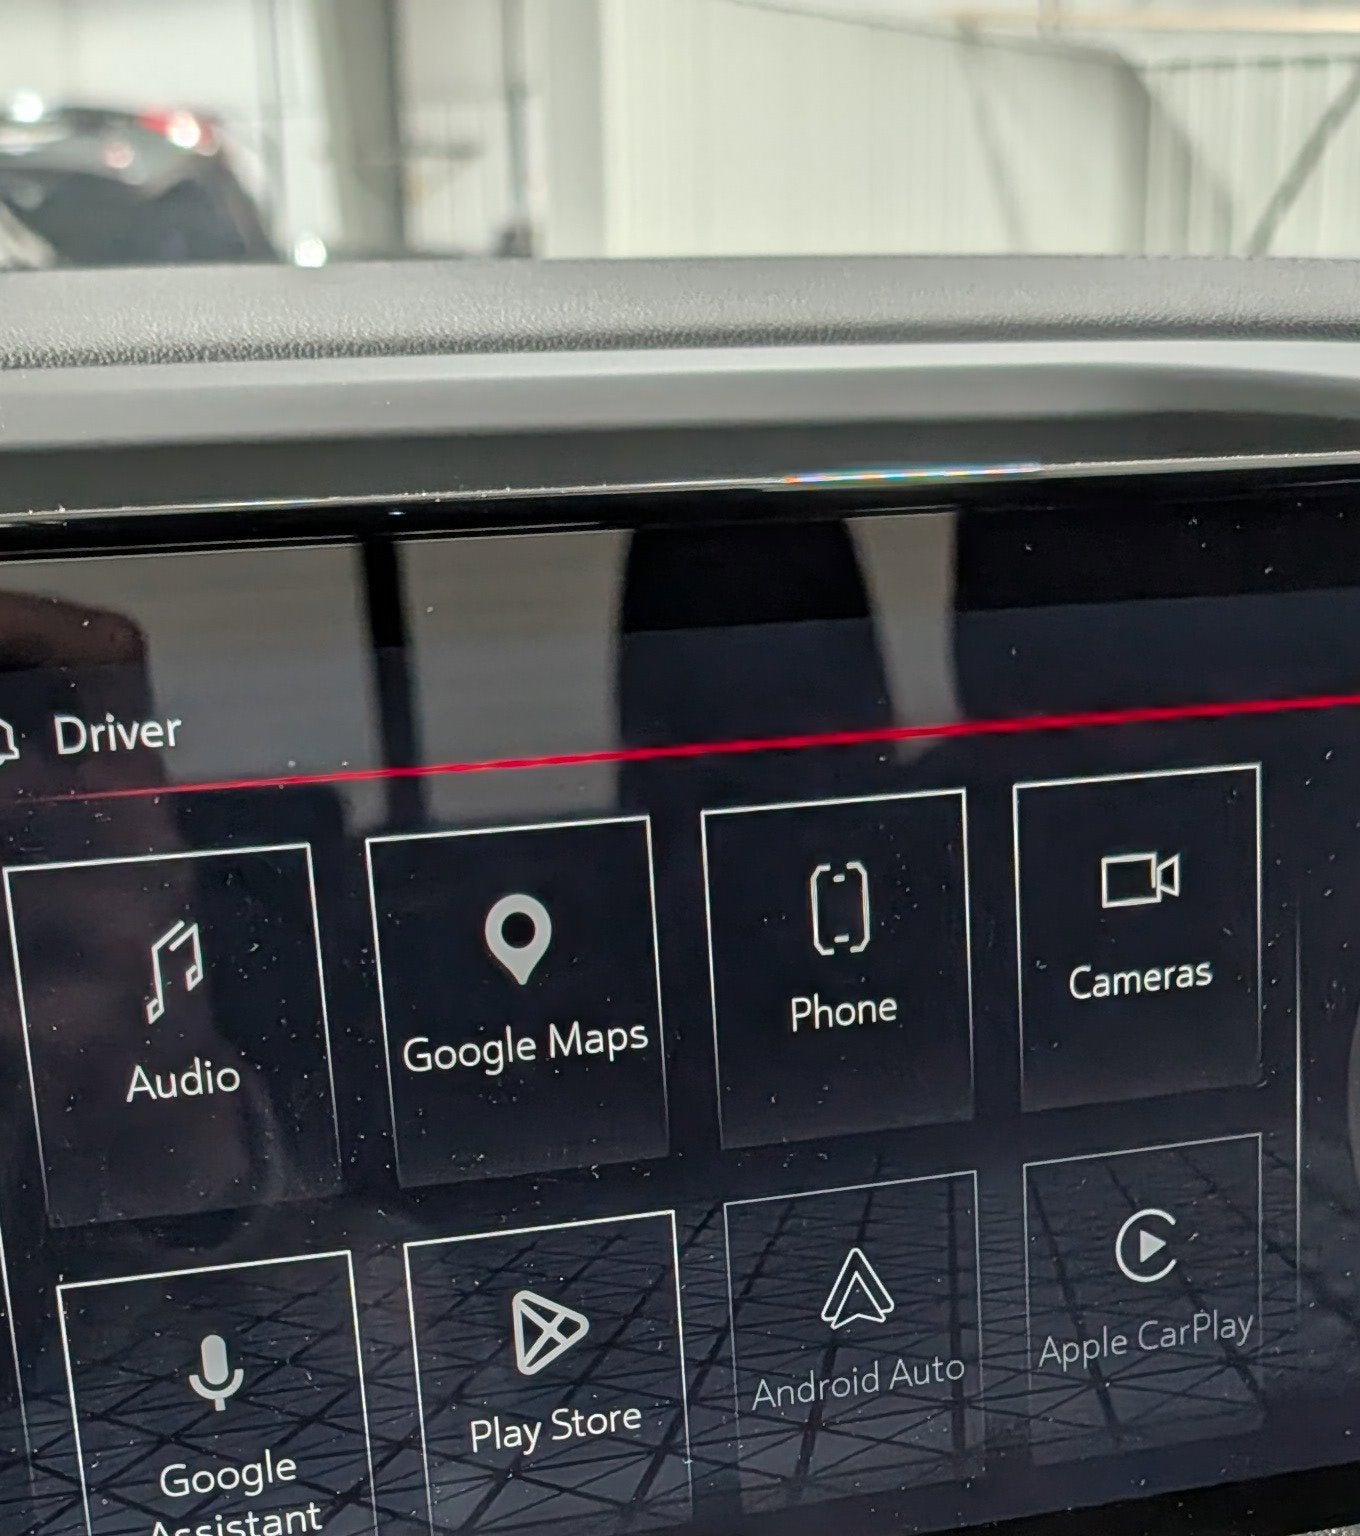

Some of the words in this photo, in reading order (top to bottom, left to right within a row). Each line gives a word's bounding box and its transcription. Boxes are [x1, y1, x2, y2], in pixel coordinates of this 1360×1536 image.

[54, 712, 182, 755] Driver
[1069, 962, 1213, 1000] Cameras
[791, 993, 898, 1032] Phone
[403, 1027, 537, 1076] Google
[549, 1021, 649, 1062] Maps
[126, 1056, 241, 1103] Audio
[1039, 1327, 1128, 1370] Apple
[1138, 1312, 1254, 1350] CarPlay
[752, 1362, 880, 1411] Android
[890, 1356, 965, 1388] Auto
[470, 1416, 542, 1456] Play
[551, 1408, 642, 1440] Store
[160, 1448, 297, 1497] Google
